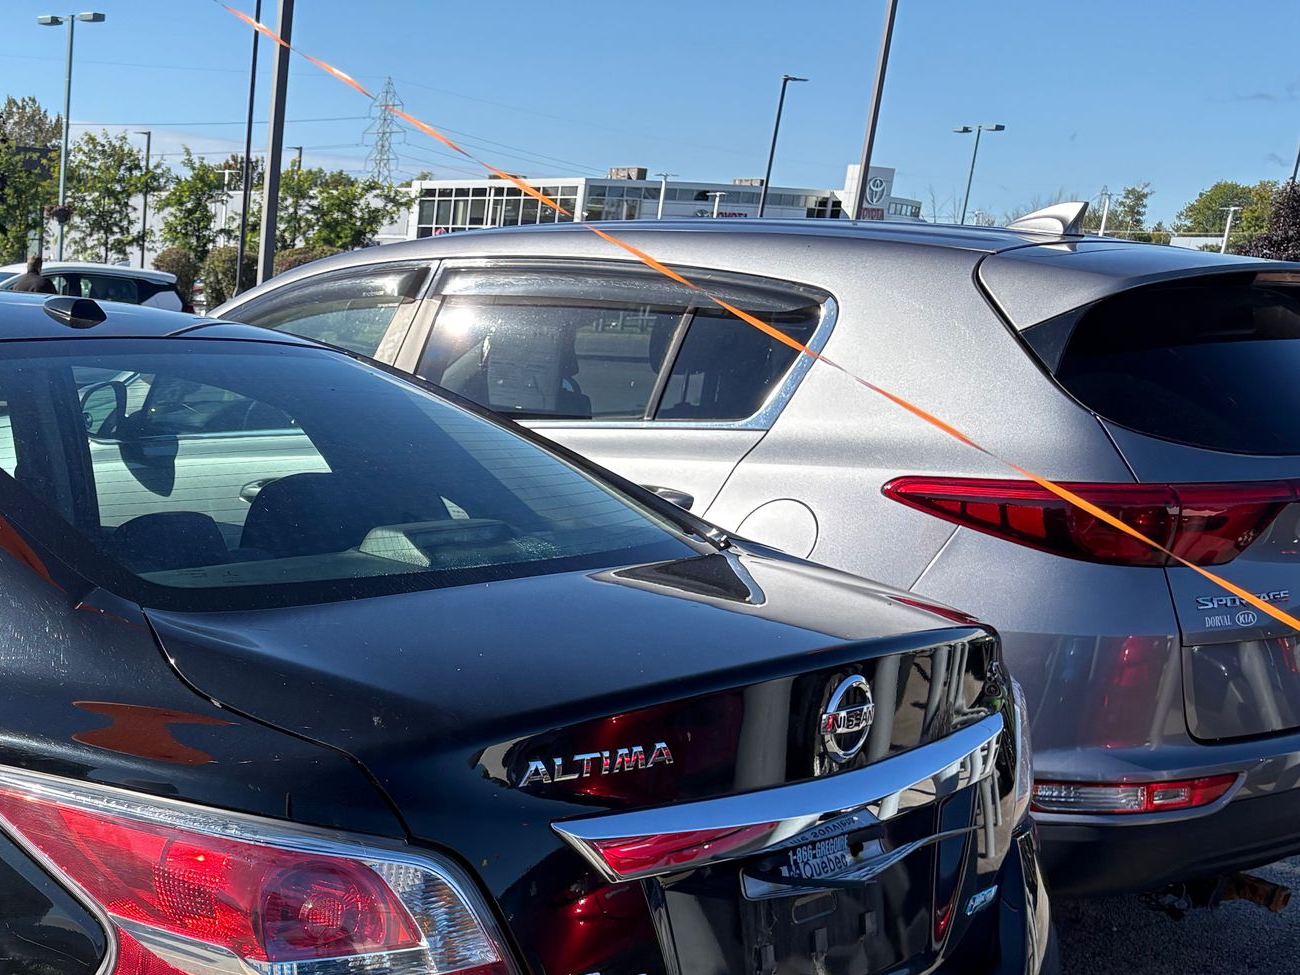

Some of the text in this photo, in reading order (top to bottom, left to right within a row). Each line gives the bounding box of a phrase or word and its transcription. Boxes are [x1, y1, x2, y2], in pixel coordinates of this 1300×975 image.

[1196, 590, 1290, 610] SPOAGE
[1205, 614, 1232, 627] DORVAL
[830, 705, 874, 731] NISSAN
[518, 741, 674, 788] ALTIMA
